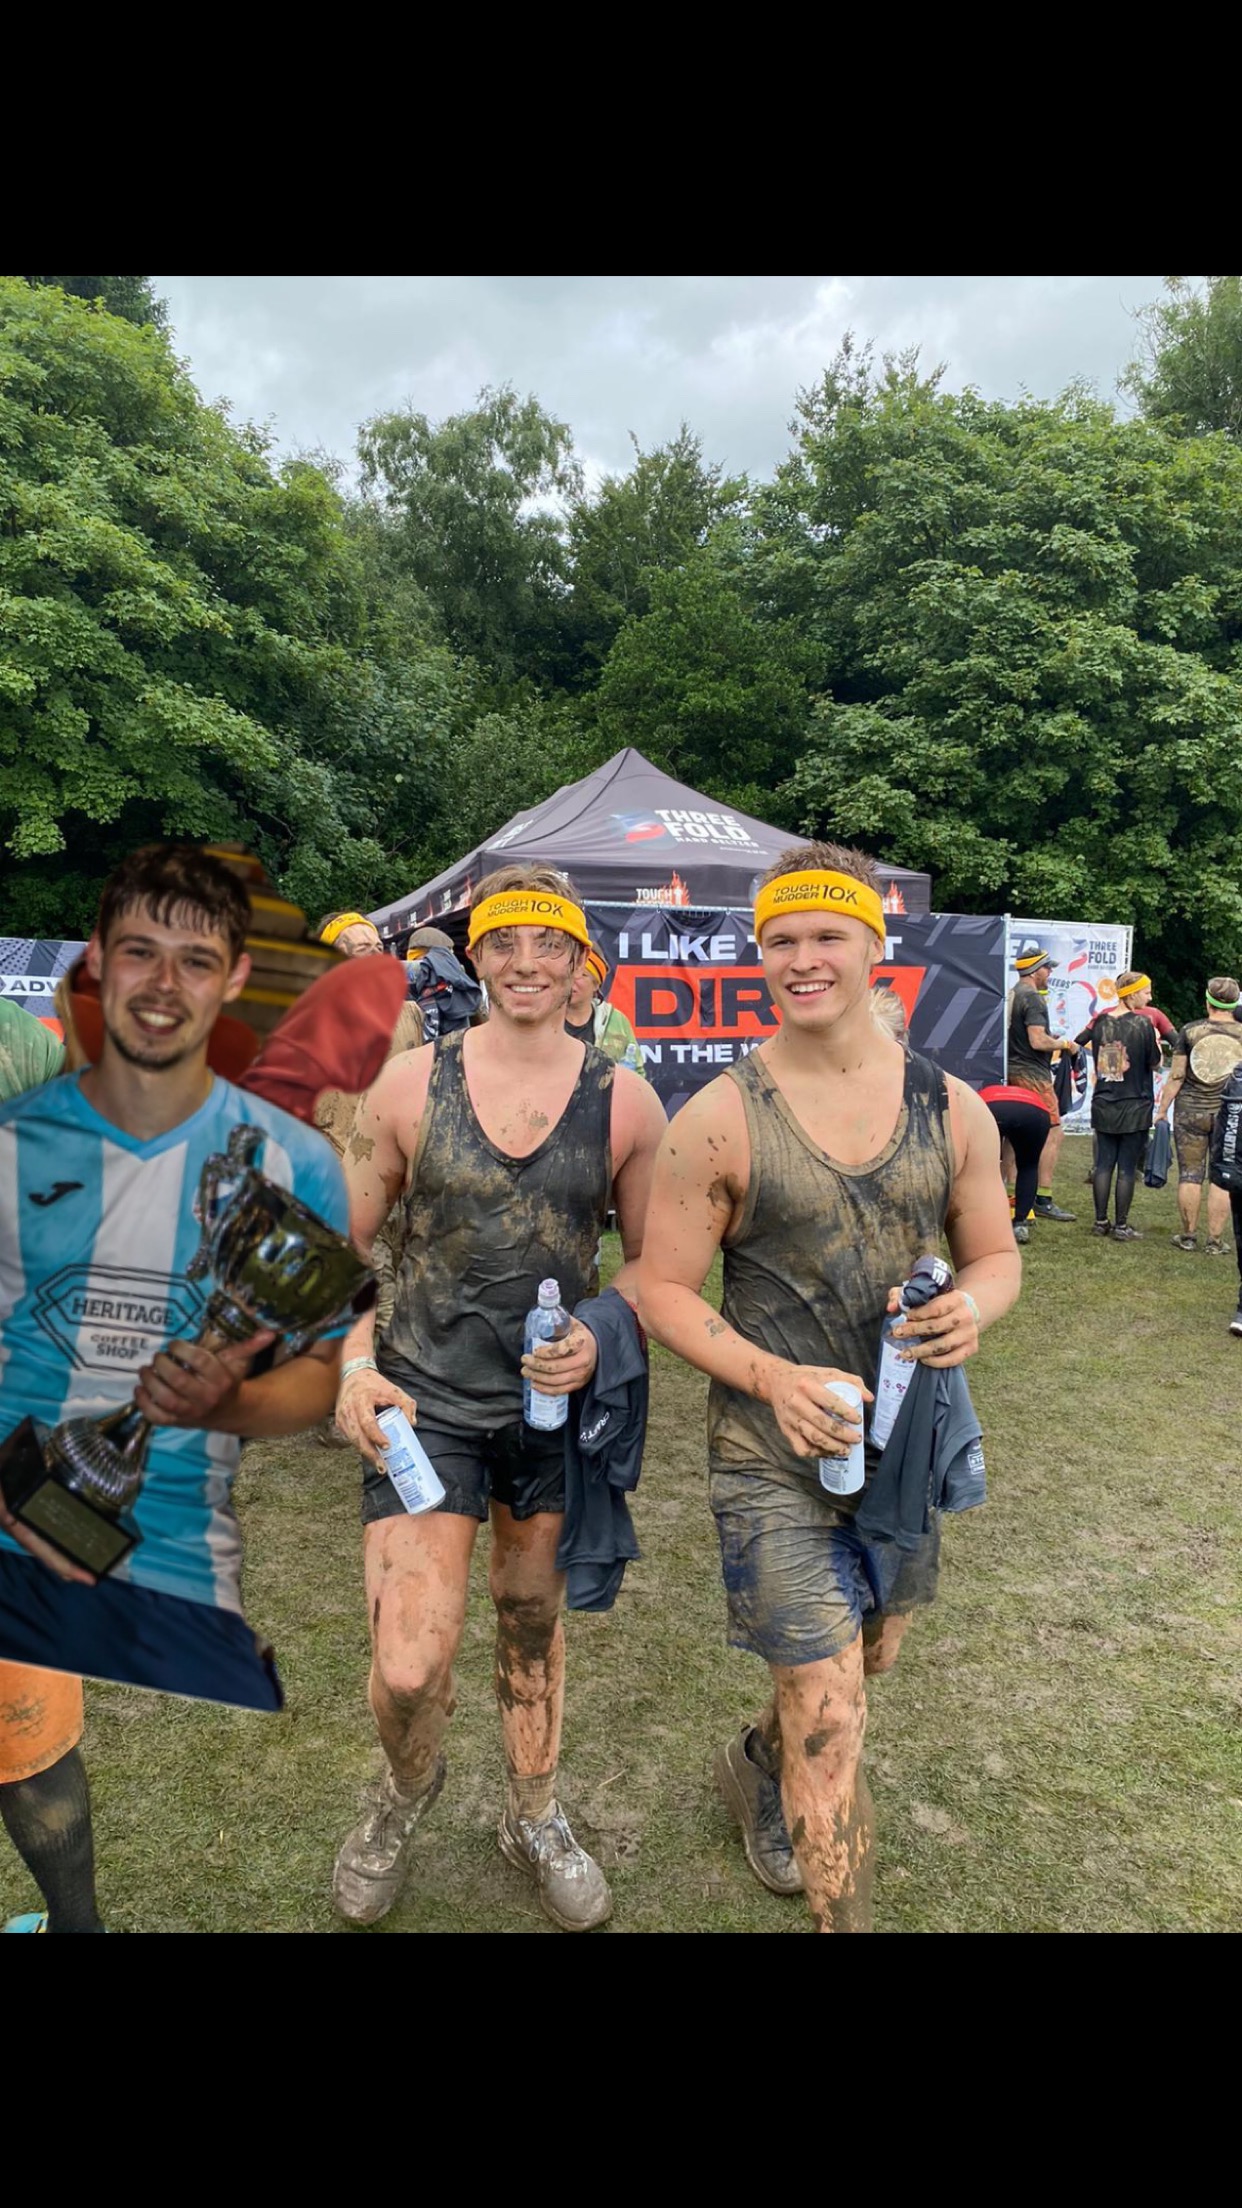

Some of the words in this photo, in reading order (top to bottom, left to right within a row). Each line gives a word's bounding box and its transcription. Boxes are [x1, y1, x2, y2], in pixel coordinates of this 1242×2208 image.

[654, 809, 740, 827] THREE
[664, 822, 752, 841] FOLD
[636, 888, 672, 900] TOUGH
[773, 884, 820, 896] TOUGH
[773, 891, 819, 904] MUDDER
[823, 884, 858, 905] 10K
[487, 906, 528, 917] MUDDER
[489, 900, 529, 911] TOUGH
[531, 900, 564, 918] 10K
[618, 932, 629, 959] I
[641, 933, 736, 961] LIKE
[1089, 941, 1117, 951] THREE
[1088, 951, 1117, 964] FOLD
[10, 980, 60, 992] ADV
[670, 1043, 733, 1063] THE
[71, 1298, 175, 1326] HERITAGE
[91, 1334, 149, 1349] COFFEE
[96, 1343, 140, 1360] SHOP
